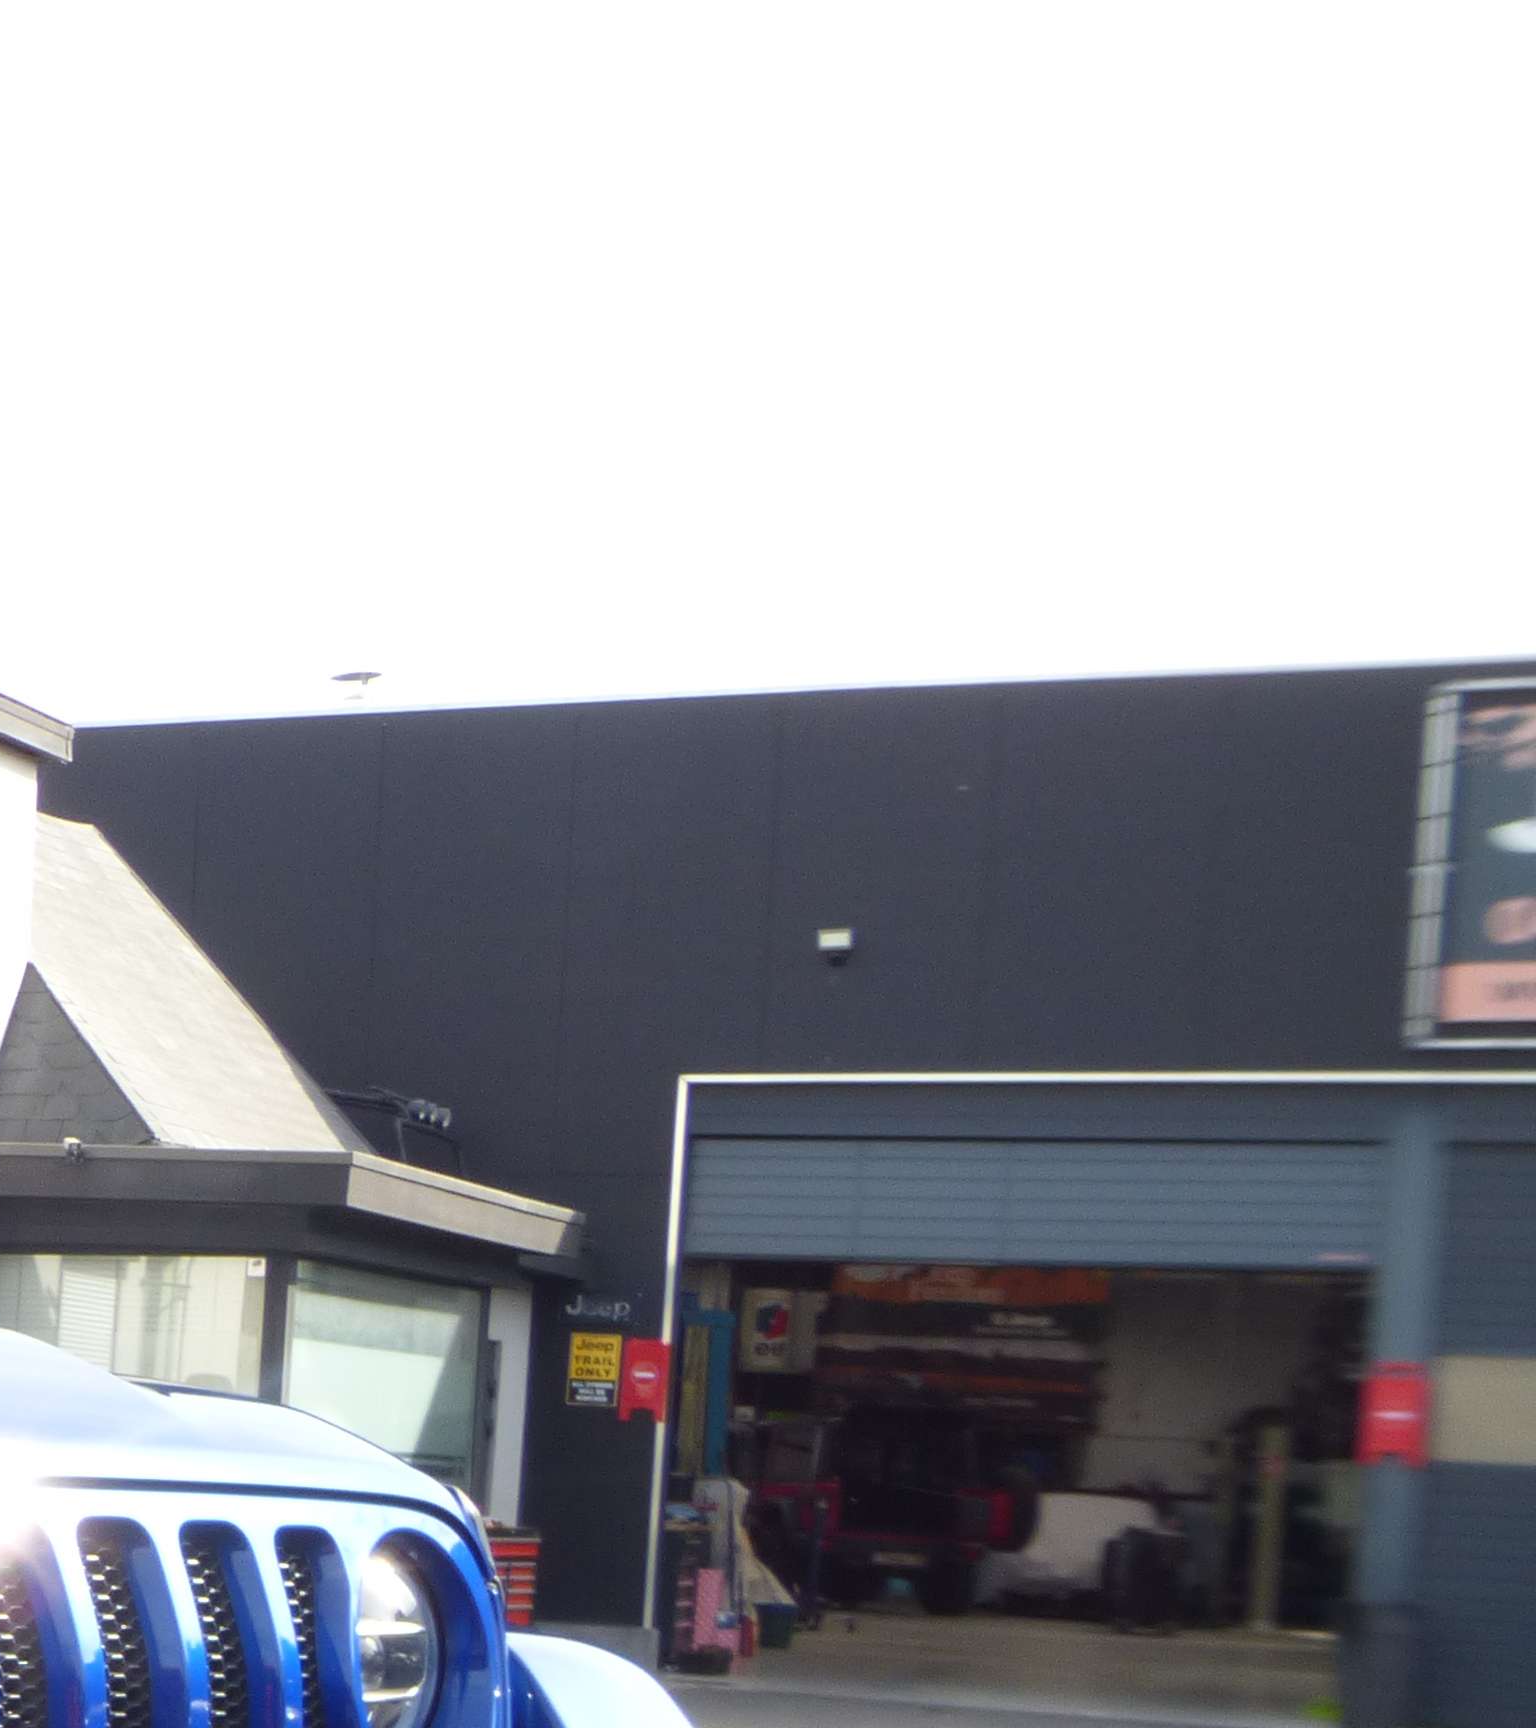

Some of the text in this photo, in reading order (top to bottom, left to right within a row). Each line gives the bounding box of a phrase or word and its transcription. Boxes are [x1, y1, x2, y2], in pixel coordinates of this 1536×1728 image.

[565, 1294, 631, 1321] Jeep
[575, 1338, 614, 1354] Jeep
[574, 1354, 615, 1367] TRAIL
[575, 1366, 610, 1378] ONLY
